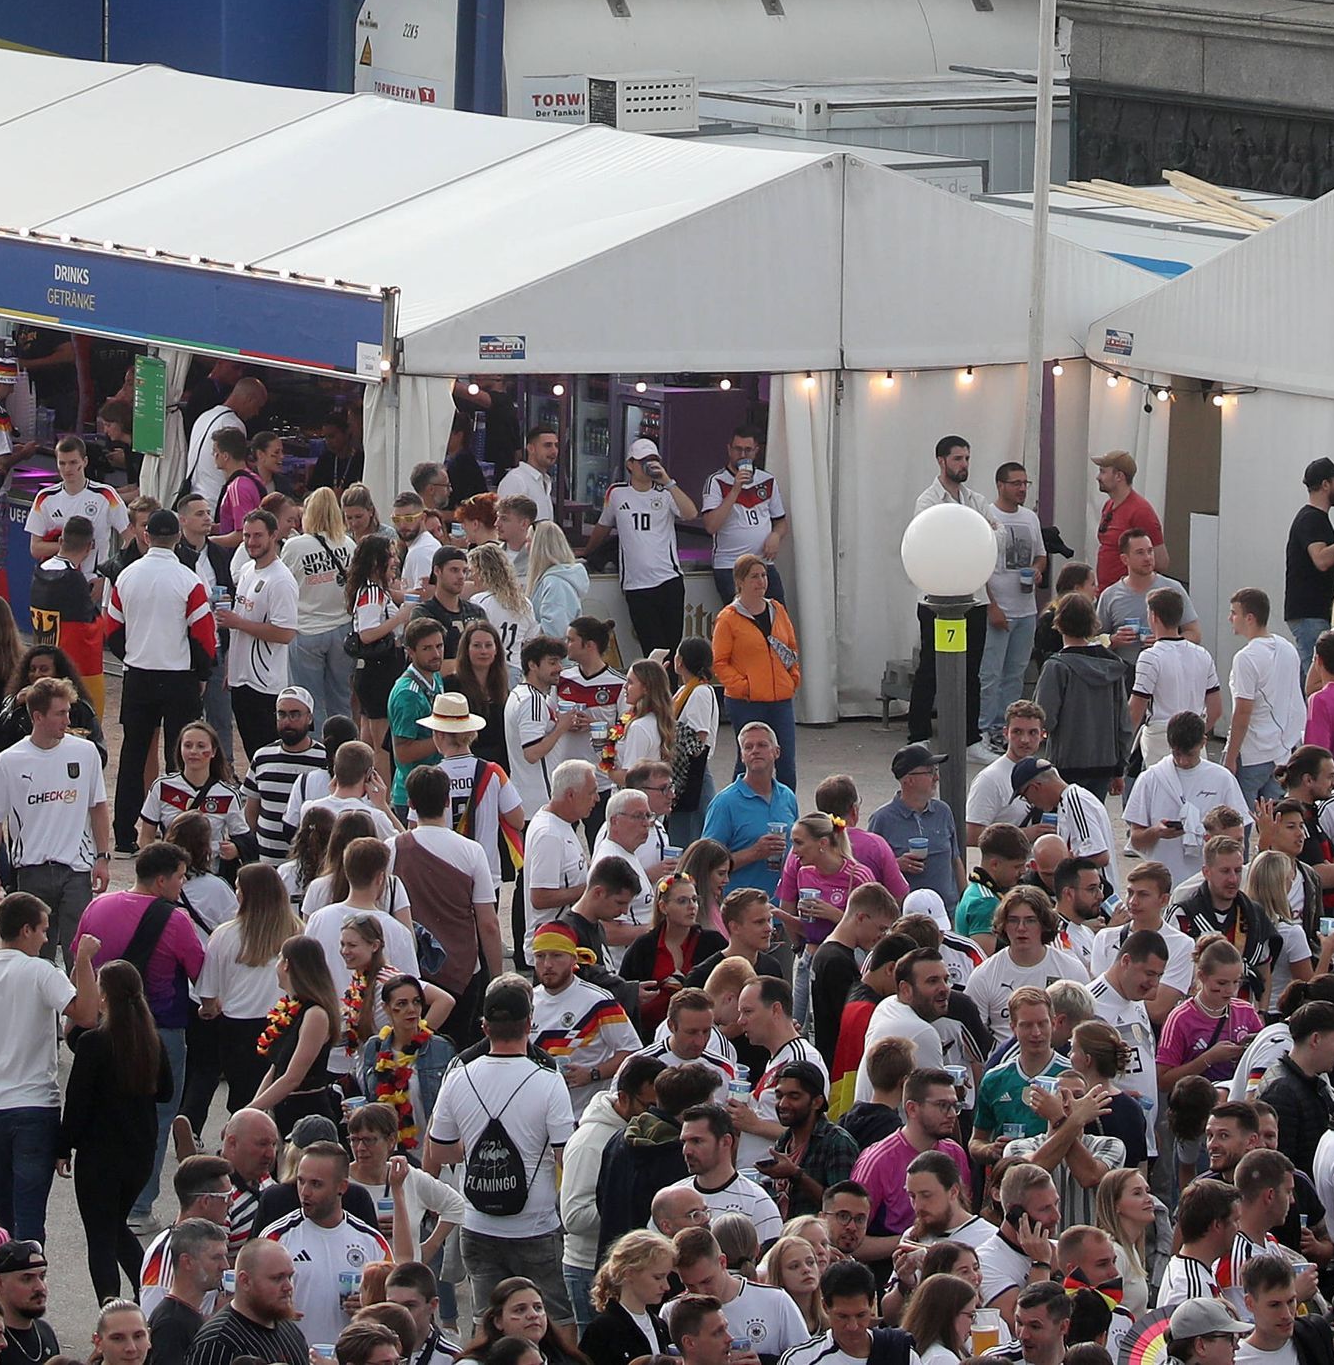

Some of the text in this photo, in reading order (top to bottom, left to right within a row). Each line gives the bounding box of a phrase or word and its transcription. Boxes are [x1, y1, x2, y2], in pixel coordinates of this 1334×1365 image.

[374, 81, 416, 100] TORWESTEN
[536, 109, 550, 117] Der
[54, 264, 90, 285] DRINKS
[47, 287, 96, 311] GETRÄNKE
[9, 506, 27, 523] UEF
[631, 513, 651, 531] 10
[745, 510, 759, 526] 19
[947, 629, 955, 643] 7
[27, 789, 77, 805] CHECK24
[466, 1175, 517, 1192] FLAMINGO
